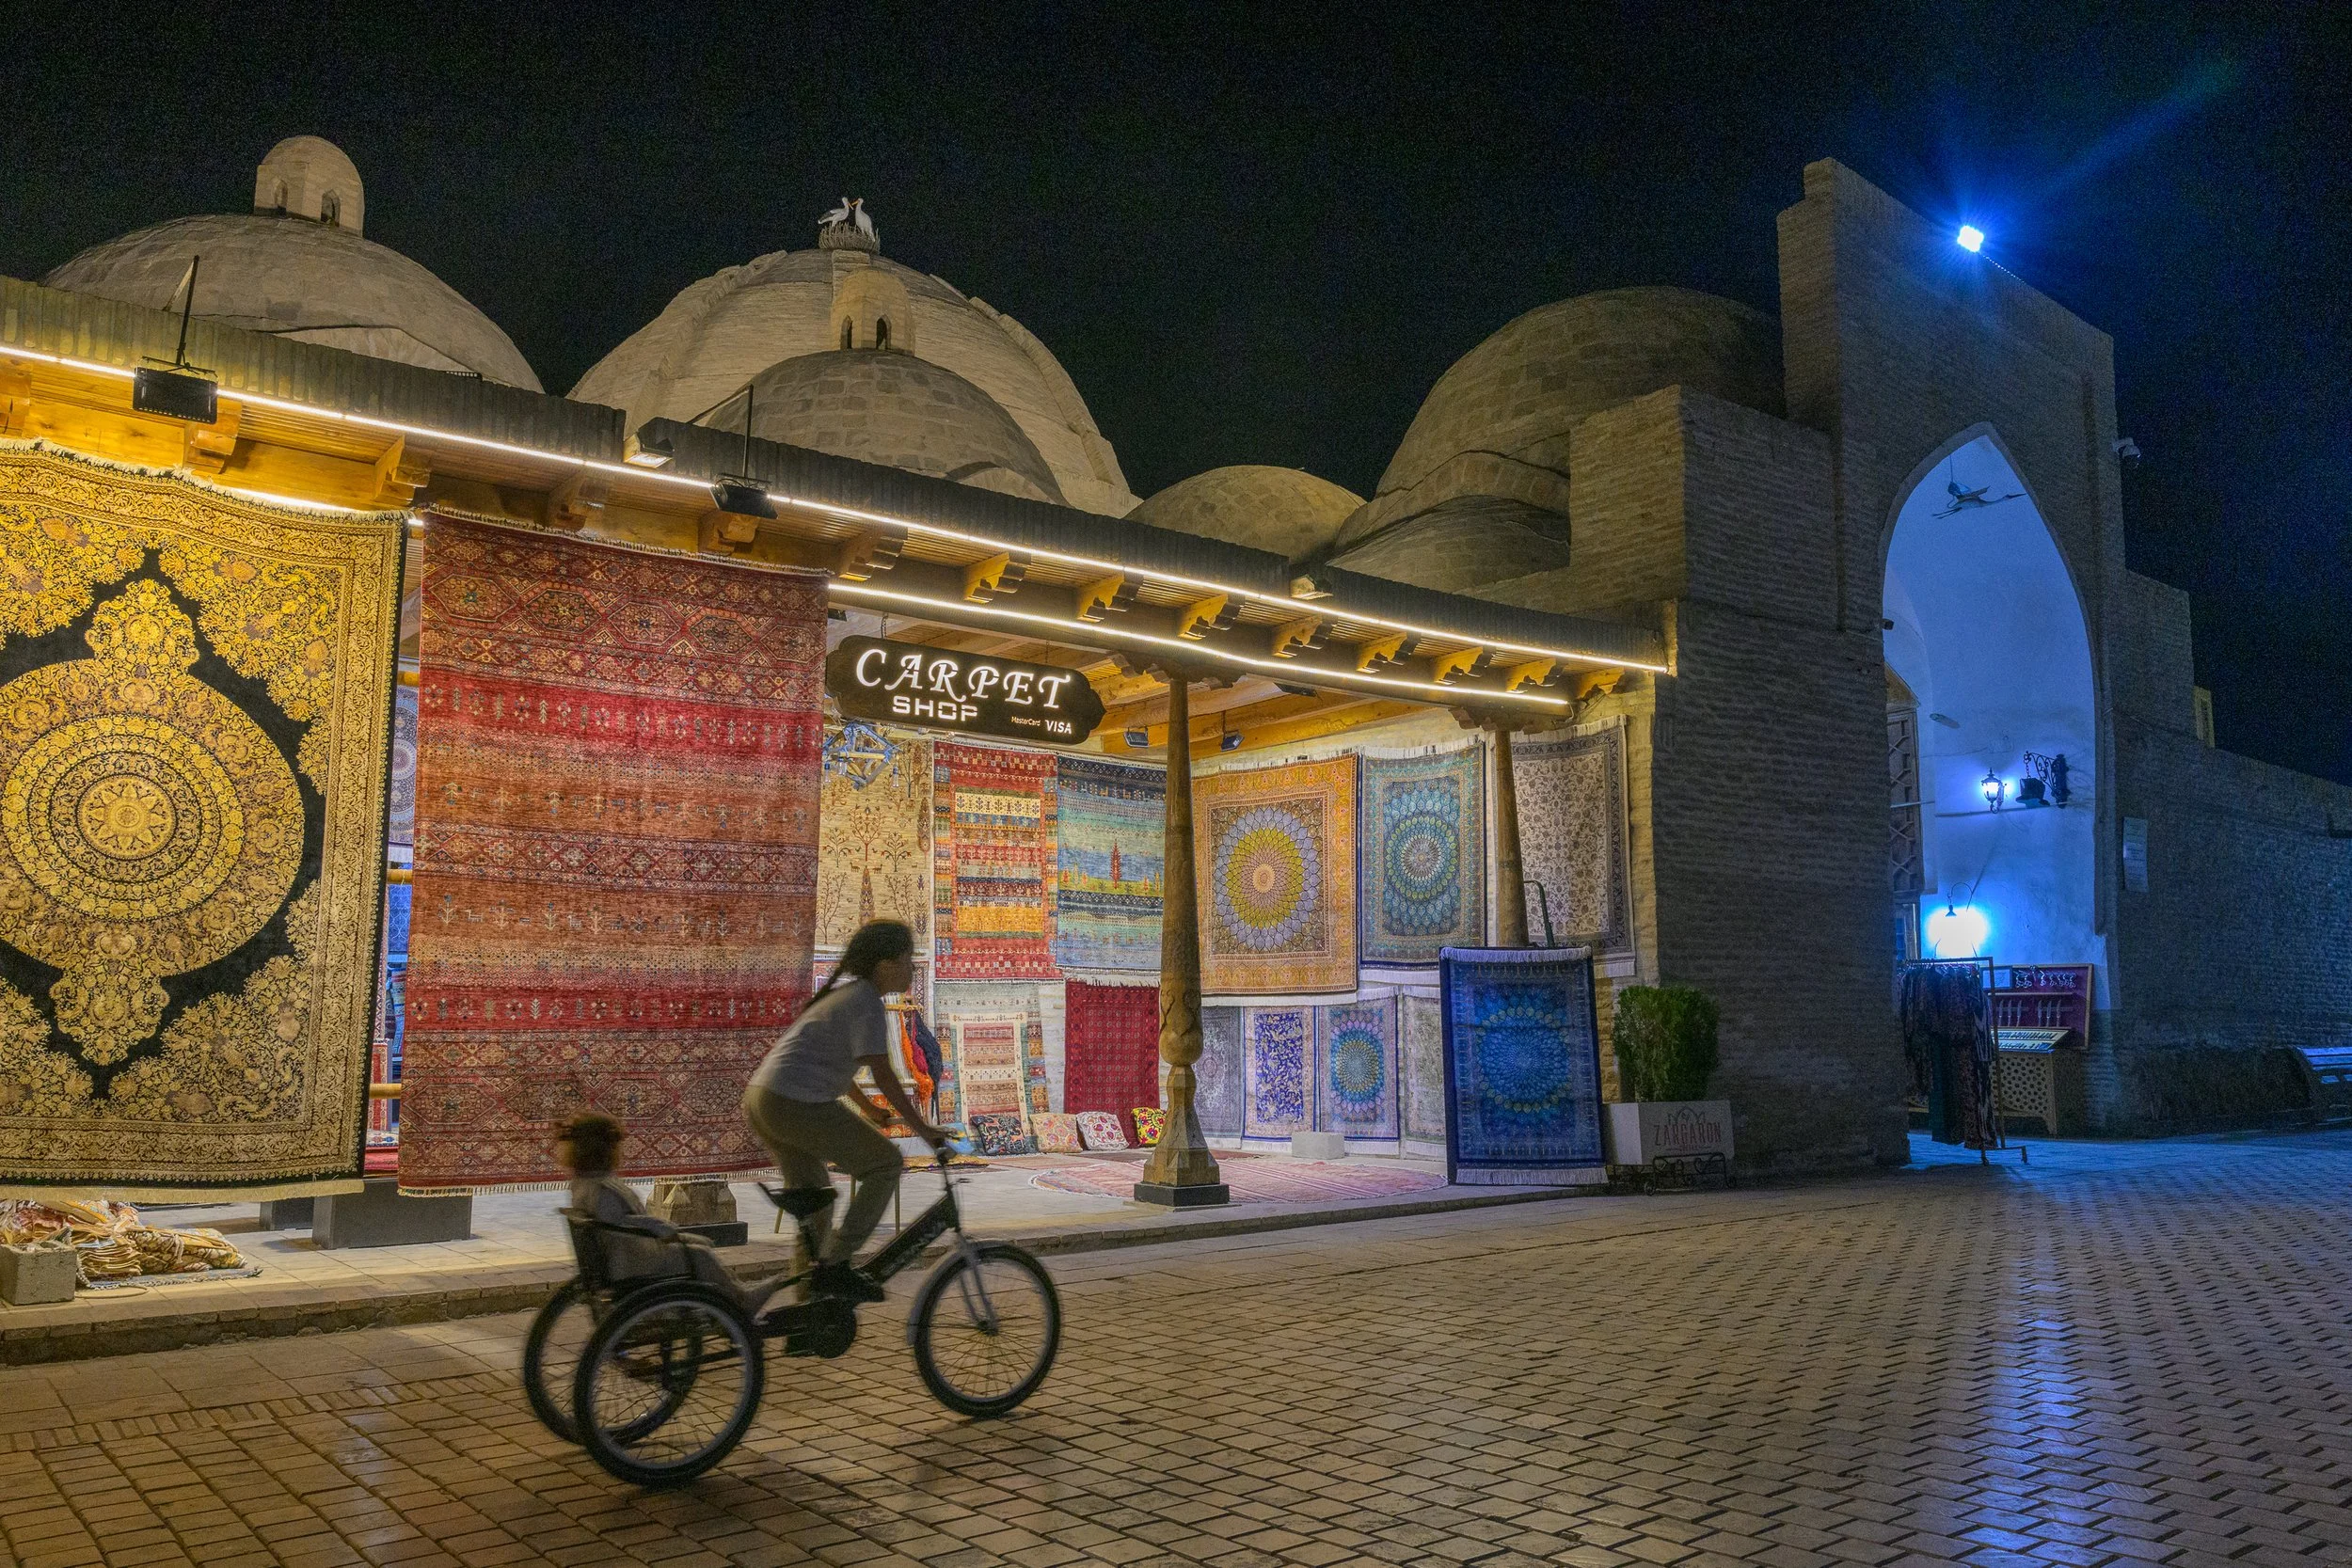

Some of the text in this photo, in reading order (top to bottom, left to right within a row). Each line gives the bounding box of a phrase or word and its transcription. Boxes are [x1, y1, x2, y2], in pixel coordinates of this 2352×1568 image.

[855, 649, 1072, 708] CARPET
[892, 696, 977, 722] SHOP
[1044, 720, 1072, 735] VISA
[1654, 1122, 1722, 1146] ZARGARON
